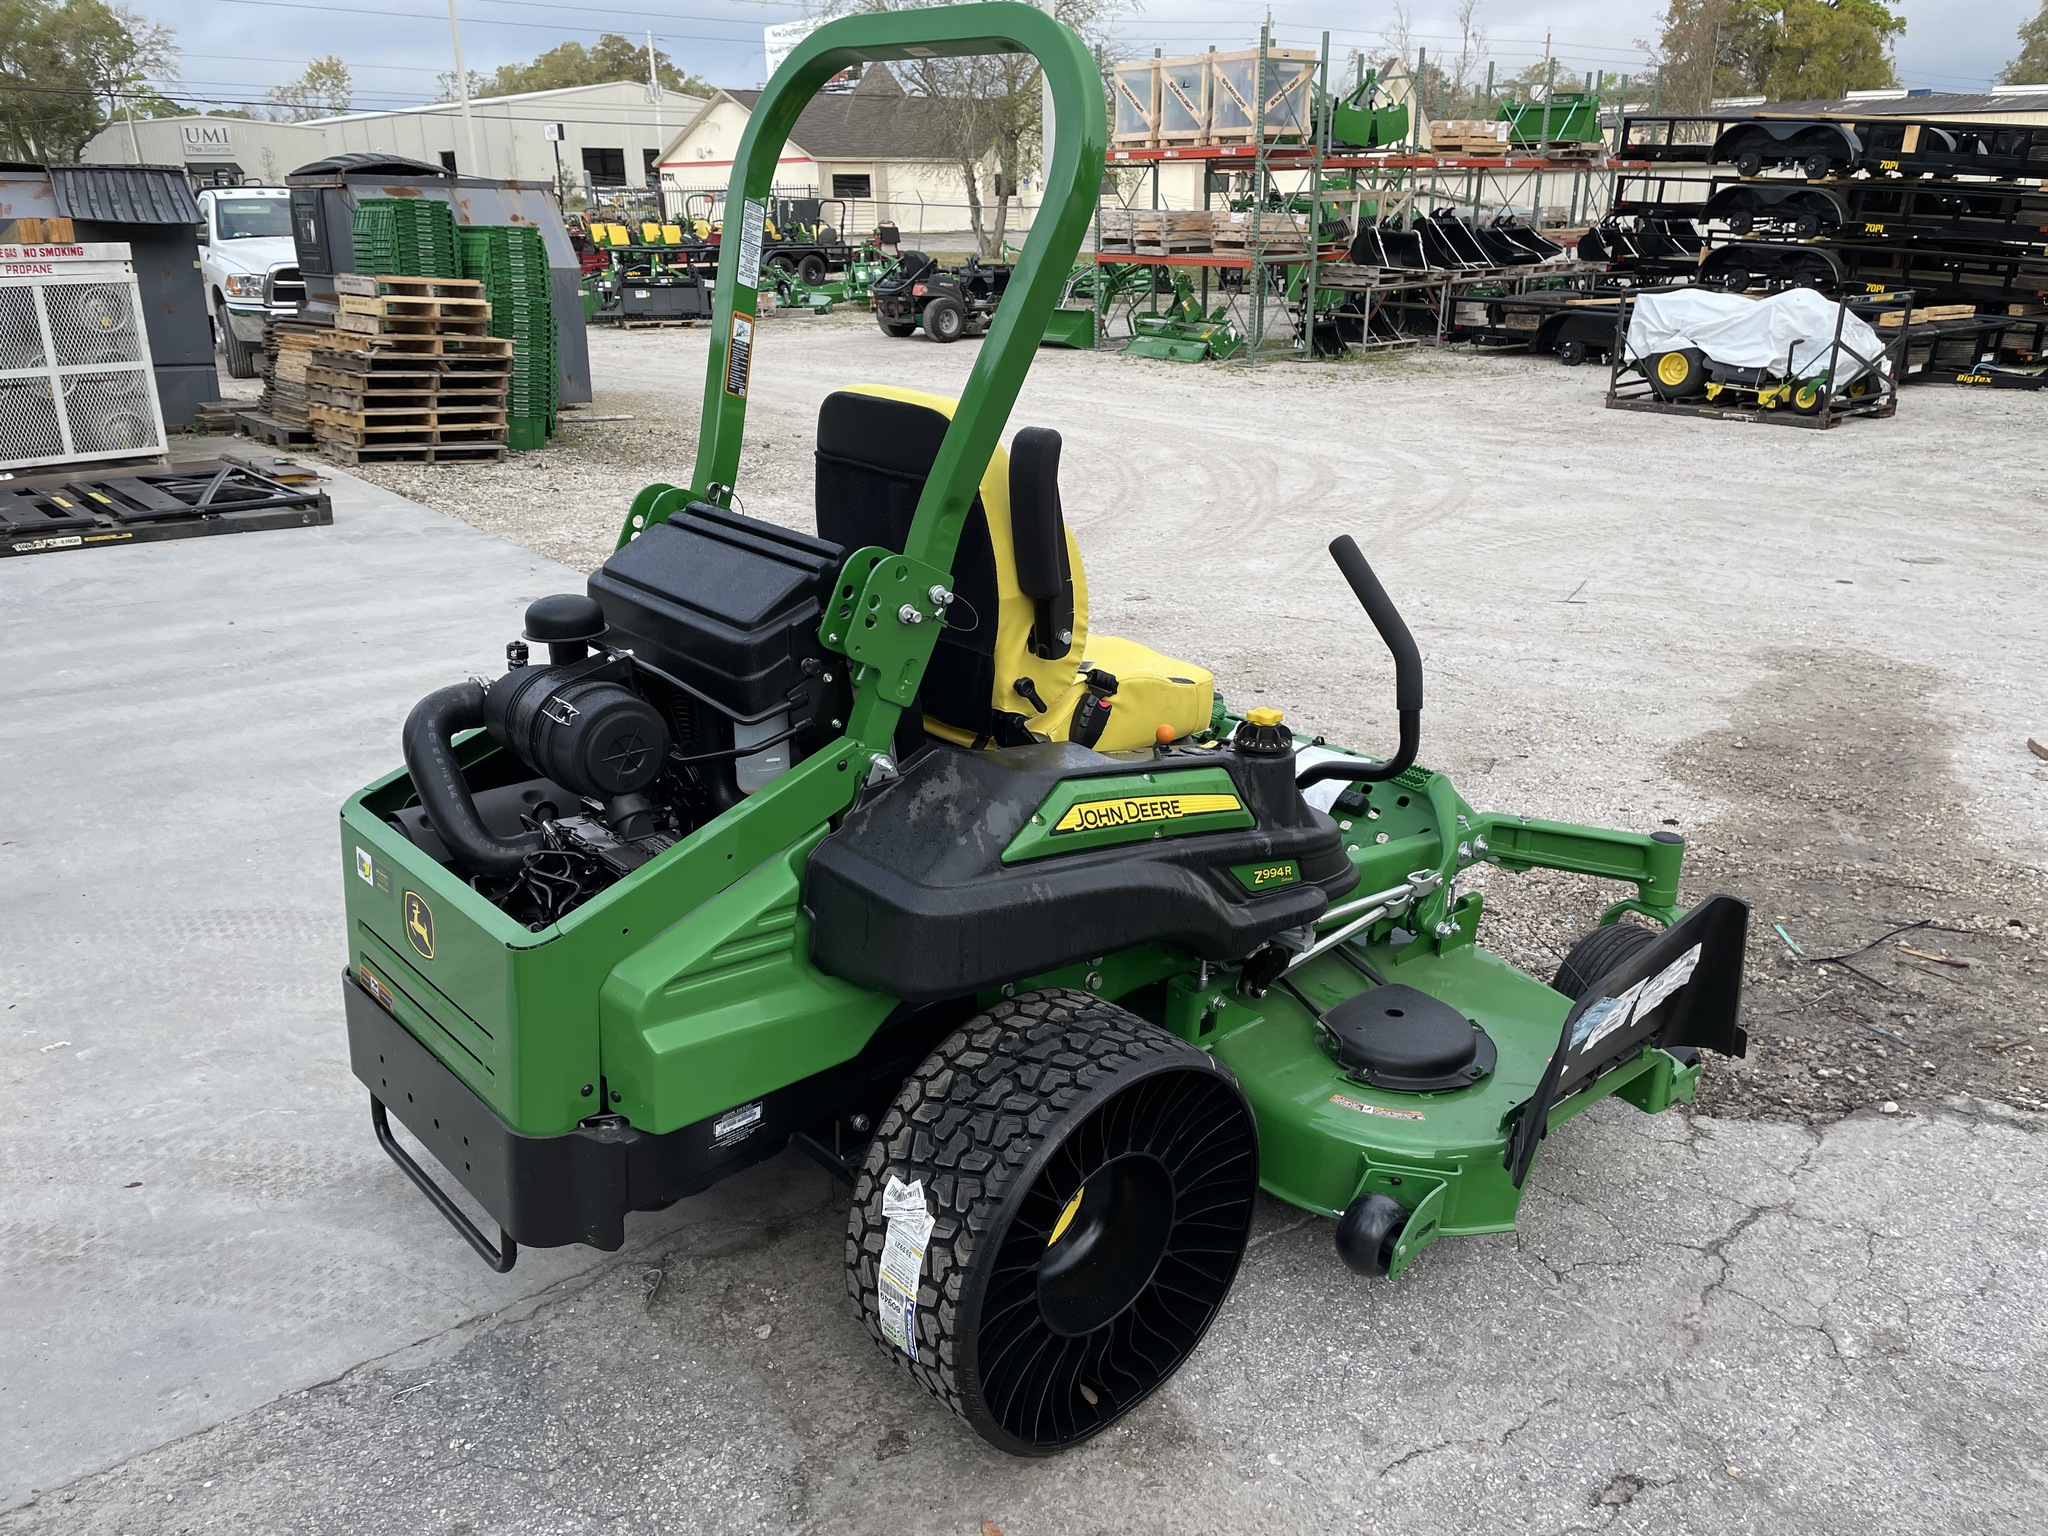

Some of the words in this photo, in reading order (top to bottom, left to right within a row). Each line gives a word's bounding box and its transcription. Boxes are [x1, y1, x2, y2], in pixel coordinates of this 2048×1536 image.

[184, 128, 230, 143] UMI
[1879, 160, 1899, 170] 70PI
[1865, 223, 1884, 233] 70PI
[5, 248, 18, 258] GAS
[23, 248, 37, 258] NO
[39, 246, 84, 257] SMOKING
[5, 264, 53, 274] PROPANE
[1865, 283, 1885, 293] 70PI
[1956, 374, 1992, 384] BigTex
[1075, 806, 1123, 828] JOHN
[1124, 800, 1182, 820] DEERE
[1254, 865, 1292, 885] Z994R
